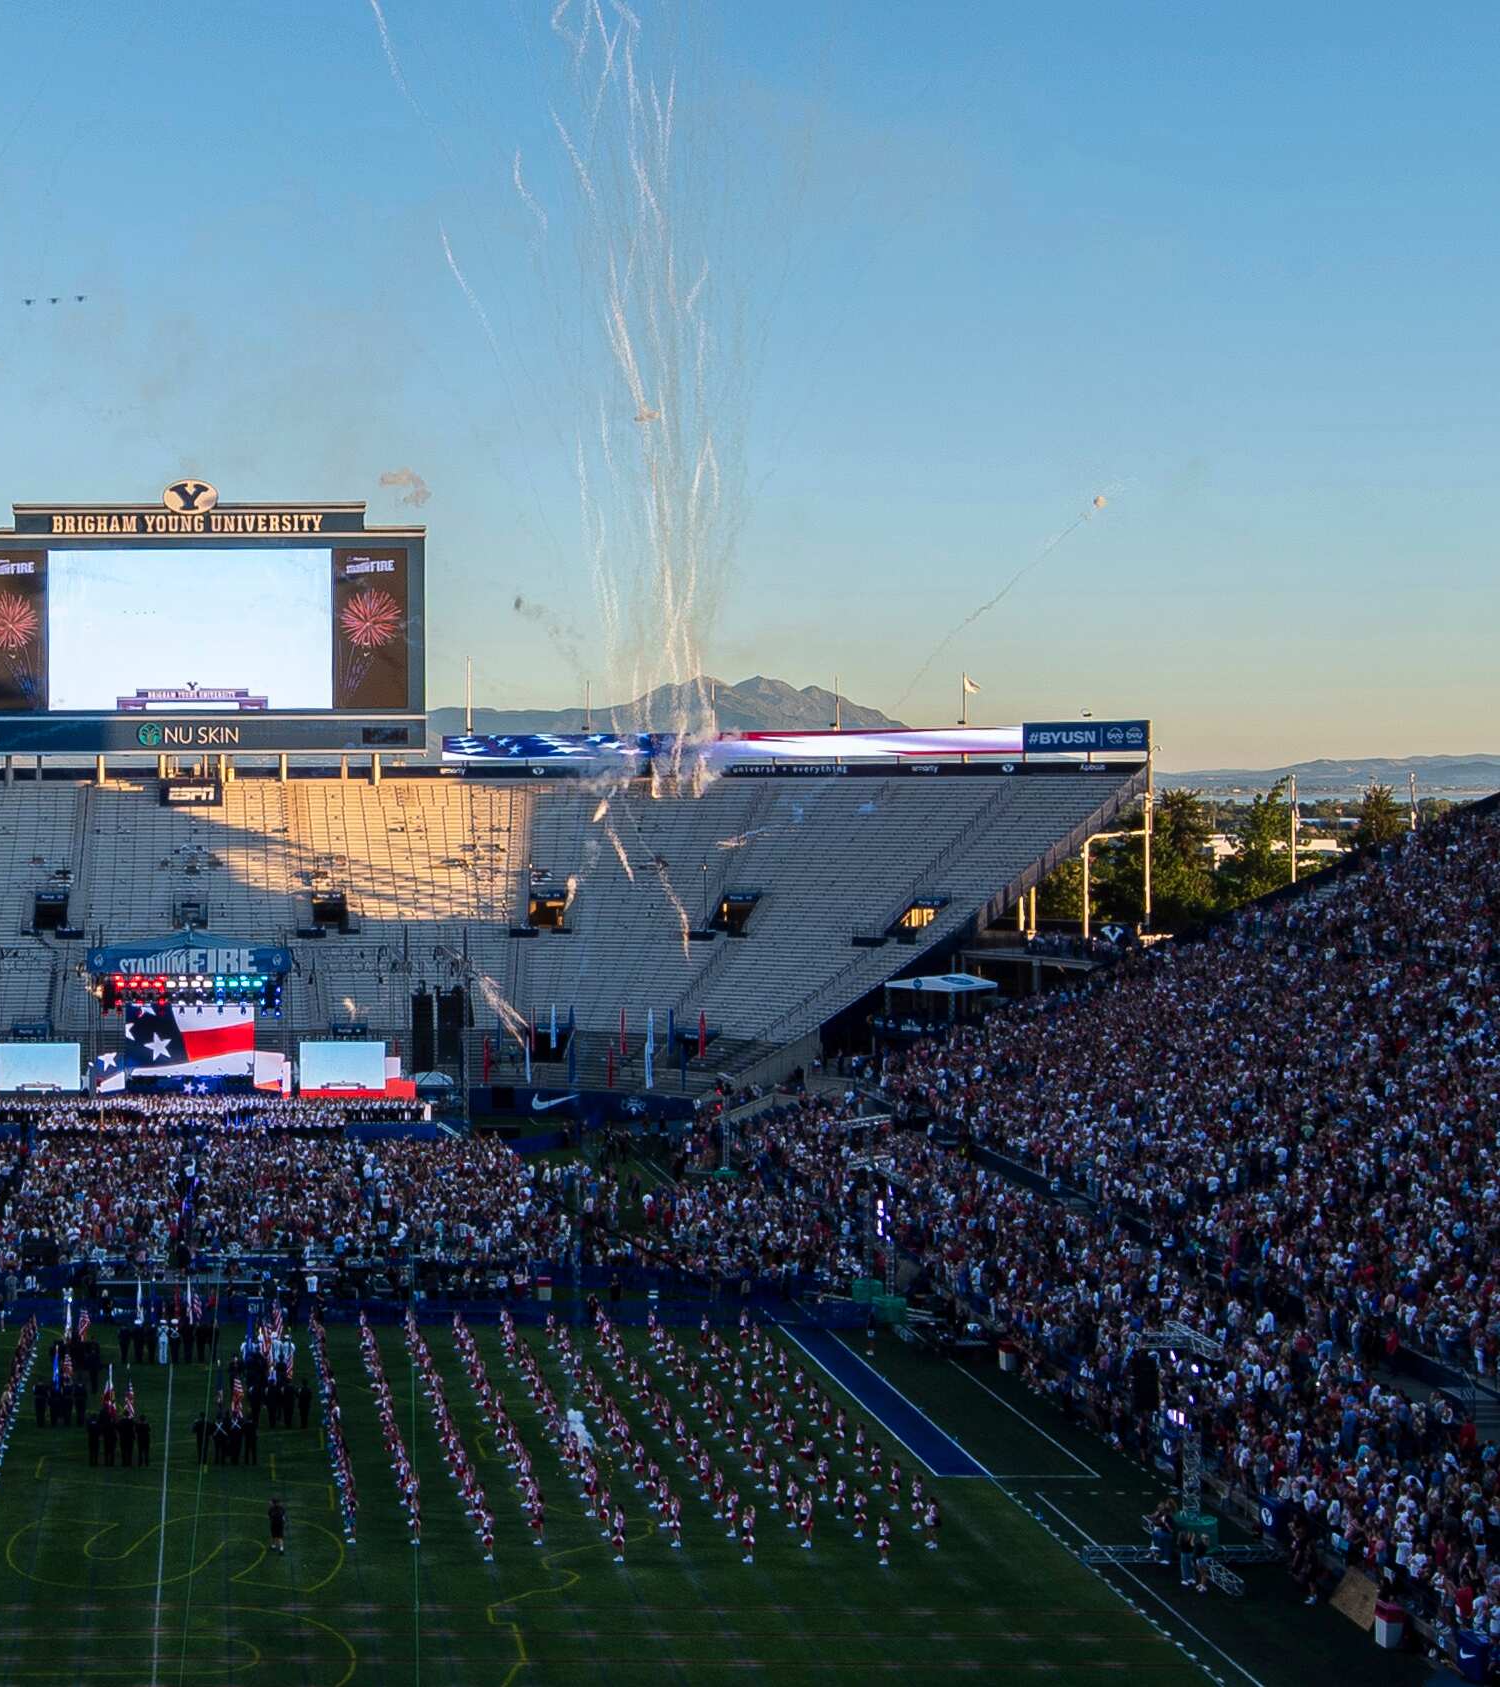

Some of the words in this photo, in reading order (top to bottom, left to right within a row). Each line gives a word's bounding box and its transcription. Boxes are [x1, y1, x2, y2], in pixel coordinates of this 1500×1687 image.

[169, 482, 210, 510] Y
[52, 514, 137, 533] BRIGHAM
[144, 514, 204, 533] YOUNG
[211, 514, 323, 532] UNIVERSITY
[164, 726, 193, 744] NU
[198, 726, 239, 744] SKIN
[1028, 730, 1096, 745] #BYUSN
[169, 786, 215, 801] ESPN
[119, 950, 187, 974] STADIUM
[187, 948, 258, 974] FIRE
